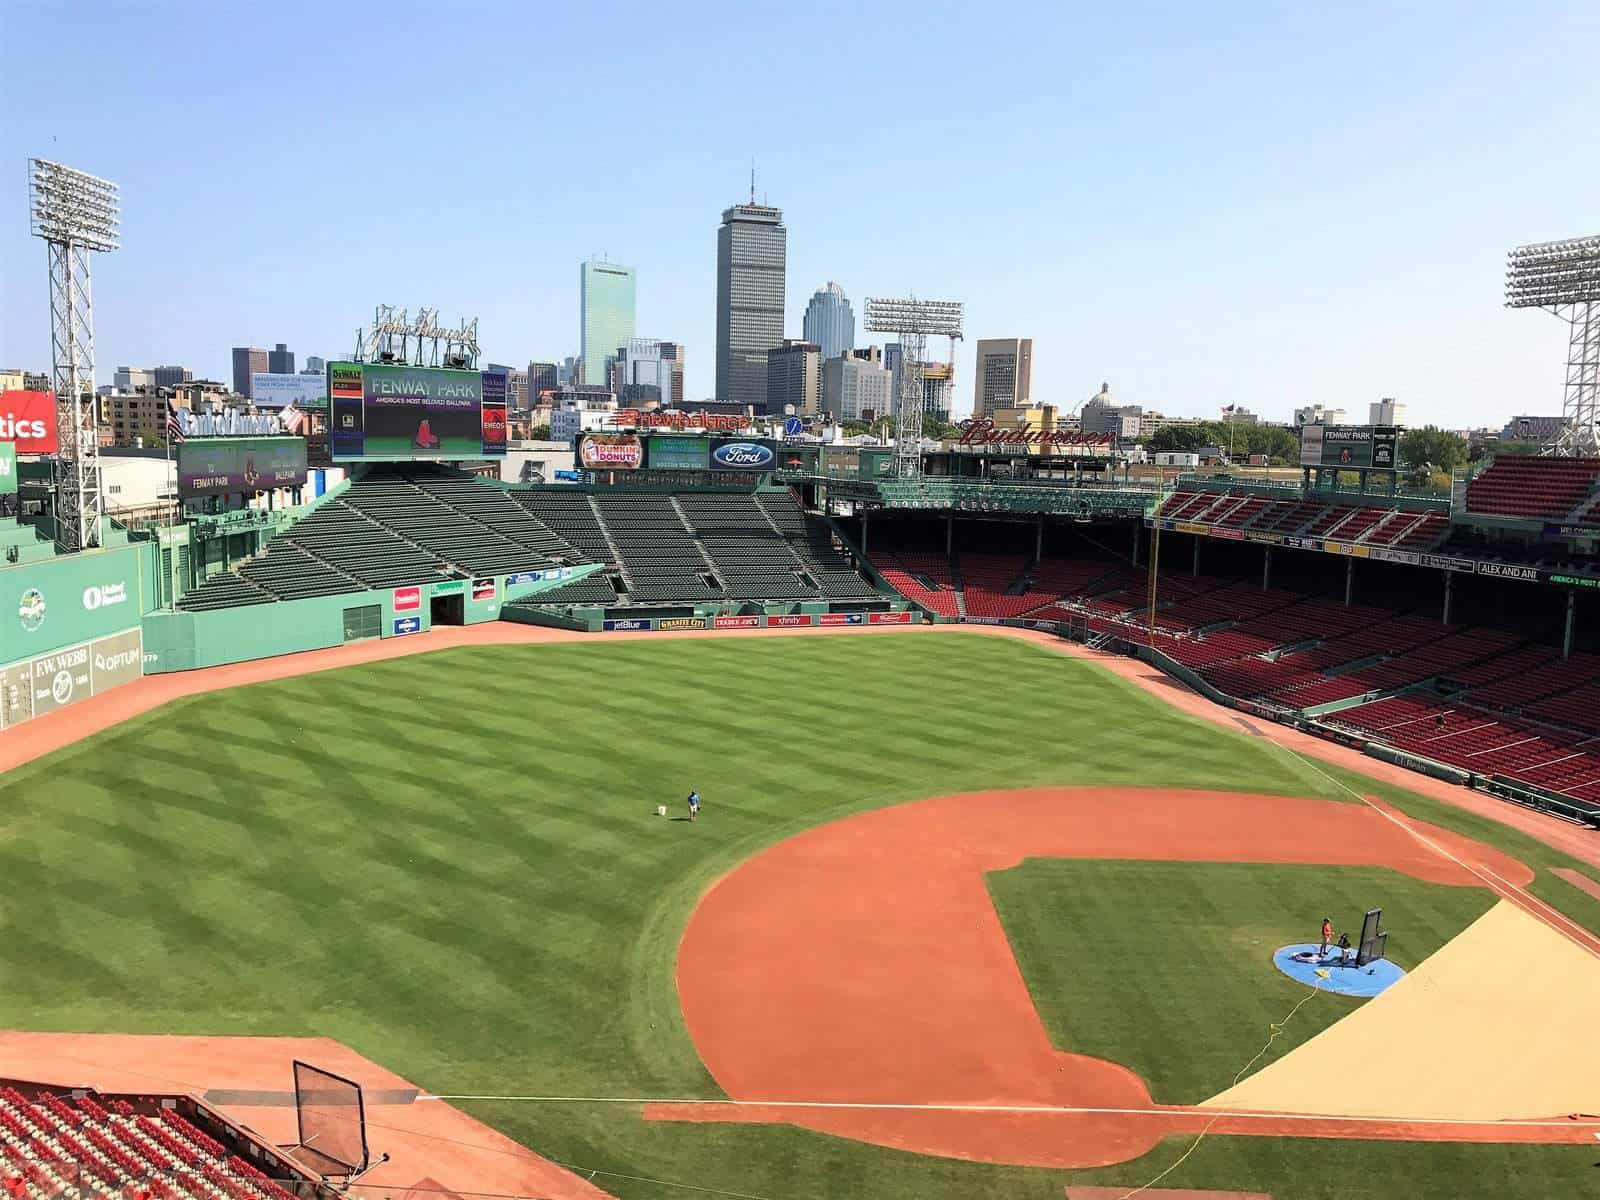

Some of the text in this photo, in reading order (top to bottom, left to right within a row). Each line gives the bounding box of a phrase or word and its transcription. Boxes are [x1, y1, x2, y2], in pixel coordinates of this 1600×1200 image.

[371, 377, 431, 395] FENWAY
[437, 381, 475, 398] PARK
[376, 396, 404, 404] AMERICA'S
[640, 411, 749, 430] new balance
[959, 418, 1117, 445] Budweiser
[1325, 431, 1351, 439] FENWAY
[1352, 432, 1370, 440] PARK
[599, 453, 637, 461] DONUTS
[725, 447, 761, 463] Ford
[193, 478, 214, 488] FENWAY
[1481, 564, 1501, 574] ALEX
[1502, 566, 1520, 577] AND
[614, 620, 640, 631] jetBlue
[777, 616, 800, 626] xfinity
[57, 649, 88, 670] WEBB
[105, 648, 139, 671] OPTUM
